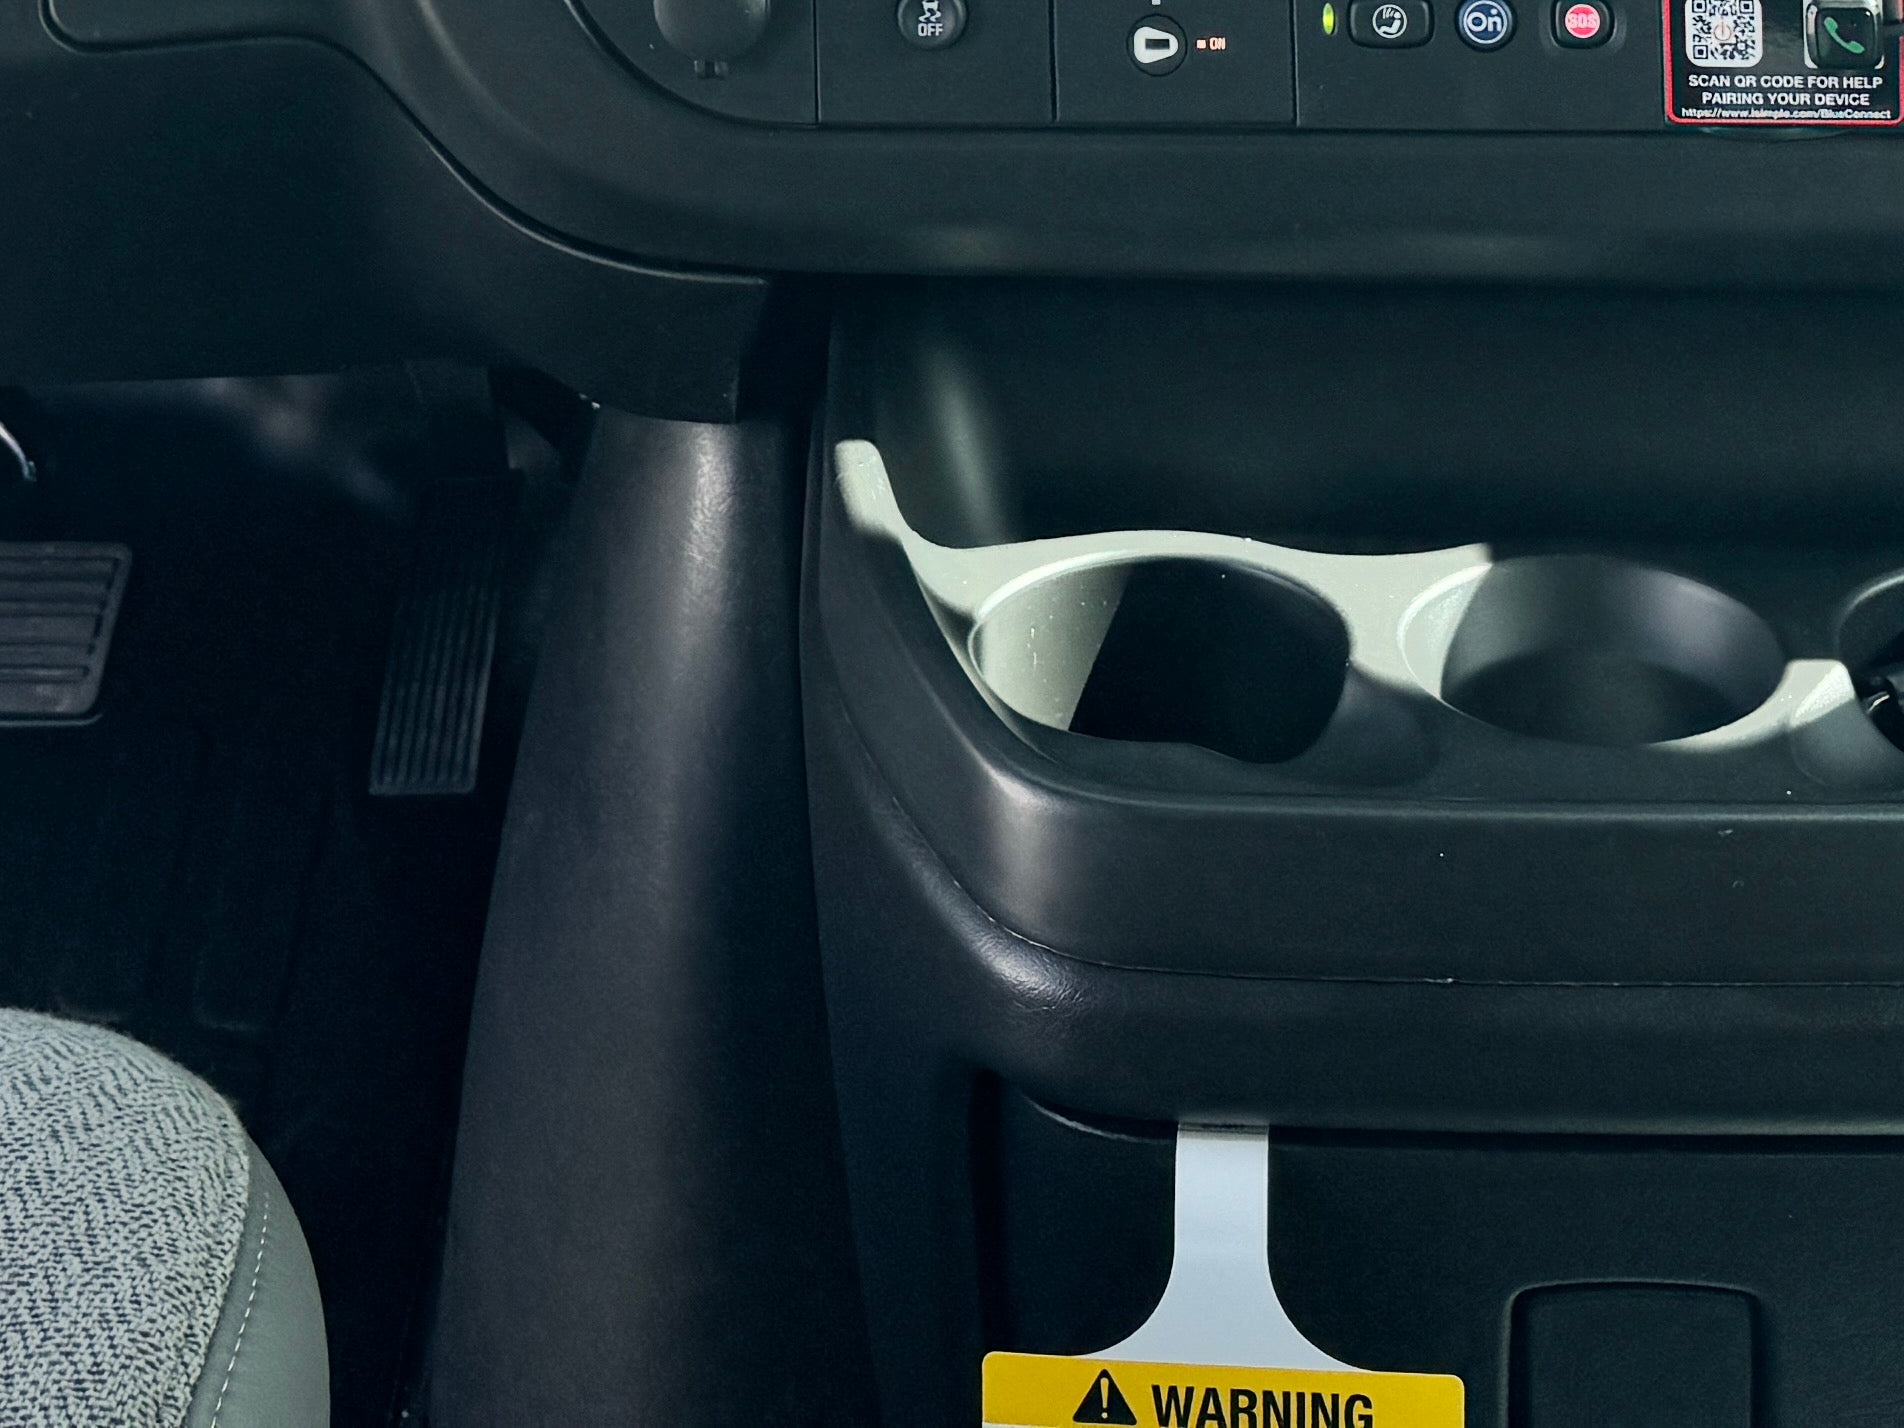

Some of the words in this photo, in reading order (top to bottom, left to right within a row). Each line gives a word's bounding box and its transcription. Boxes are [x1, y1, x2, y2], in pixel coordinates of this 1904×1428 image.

[1567, 12, 1598, 29] SOS
[917, 21, 945, 39] OFF
[1209, 37, 1226, 50] ON
[1688, 74, 1730, 88] SCAN
[1734, 75, 1757, 88] QR
[1760, 76, 1804, 88] CODE
[1807, 76, 1839, 89] FOR
[1843, 76, 1883, 89] HELP
[1702, 92, 1764, 105] PAIRING
[1768, 93, 1811, 106] YOUR
[1814, 93, 1870, 106] DEVICE
[1151, 1384, 1373, 1428] WARNING
